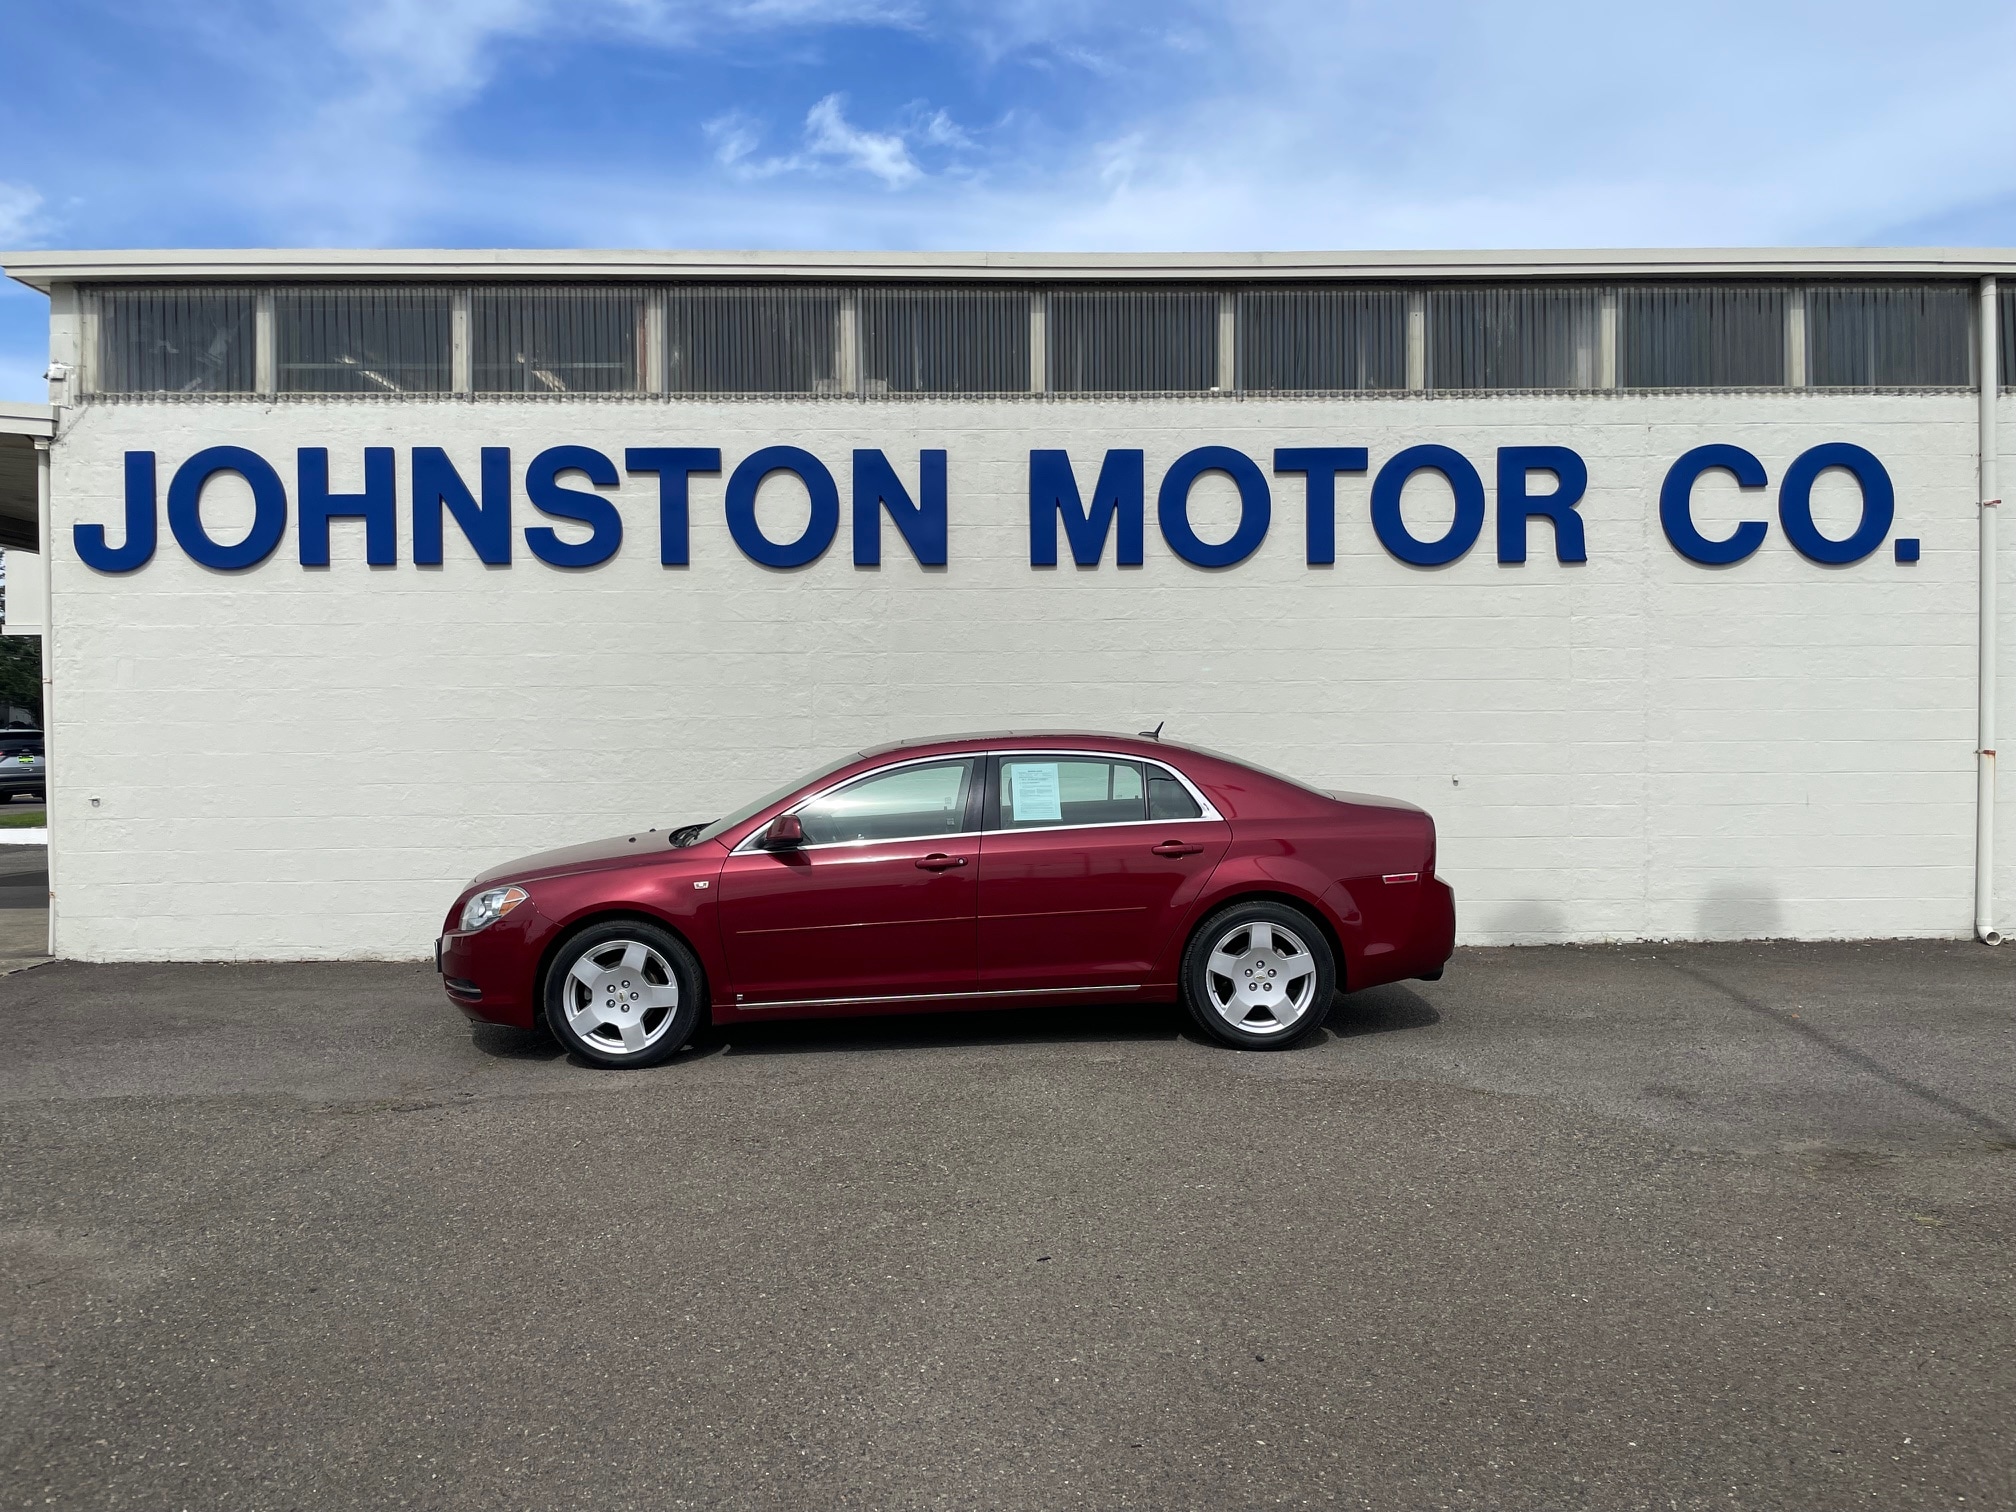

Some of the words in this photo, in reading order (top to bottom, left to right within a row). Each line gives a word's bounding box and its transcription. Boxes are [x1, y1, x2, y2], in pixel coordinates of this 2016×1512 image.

[73, 445, 947, 573] JOHNSTON
[1030, 444, 1588, 567] MOTOR
[1661, 442, 1920, 566] CO.
